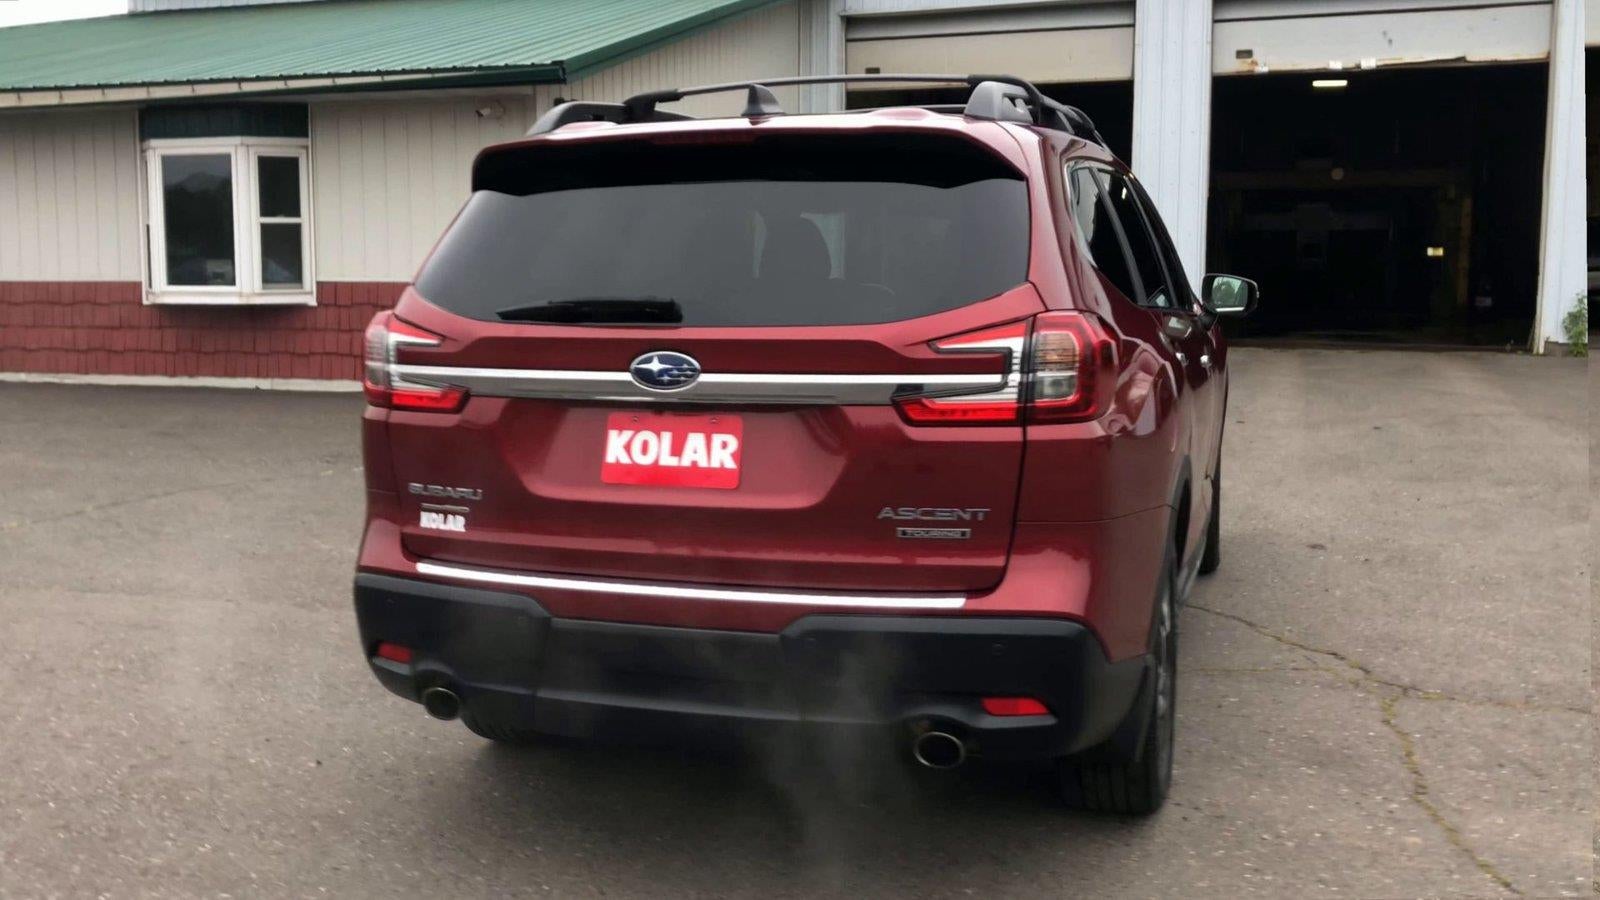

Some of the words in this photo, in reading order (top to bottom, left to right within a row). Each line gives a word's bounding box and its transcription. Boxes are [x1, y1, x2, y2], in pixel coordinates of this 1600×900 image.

[605, 429, 739, 469] KOLAR
[420, 511, 466, 532] KOLAR
[877, 507, 991, 520] ASCENT
